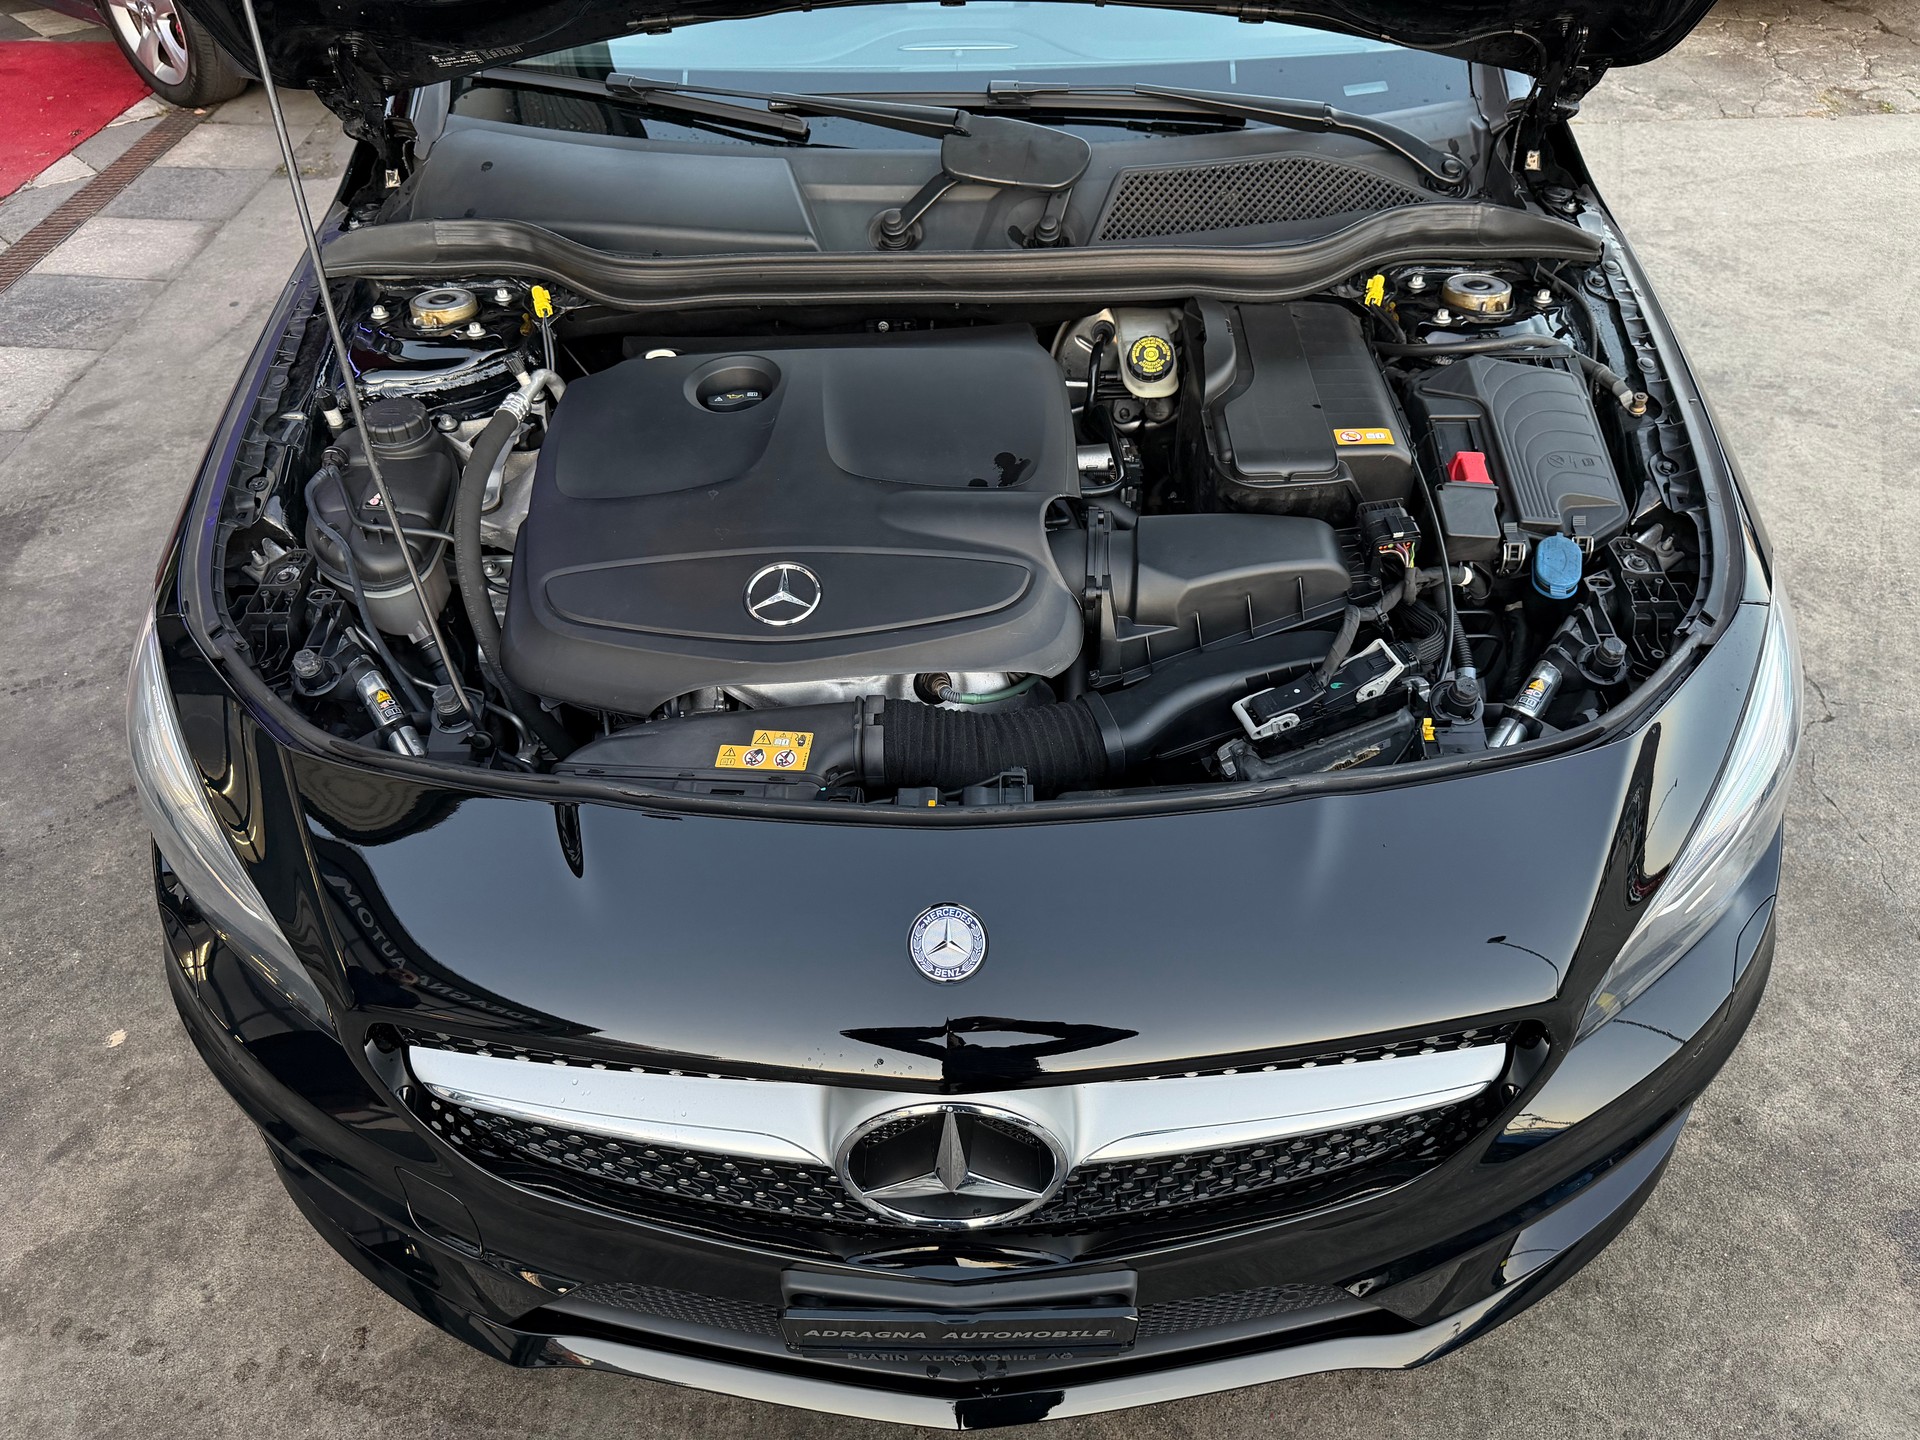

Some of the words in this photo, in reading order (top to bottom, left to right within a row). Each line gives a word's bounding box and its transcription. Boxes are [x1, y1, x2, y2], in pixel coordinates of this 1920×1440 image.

[923, 908, 973, 925] MERCEDES
[934, 968, 961, 977] BENZ
[803, 1329, 927, 1339] ADRAGNA
[942, 1329, 1111, 1339] AUTOMOBILE
[847, 1352, 909, 1362] PLATIN
[919, 1353, 1037, 1362] AUTOMOBILE
